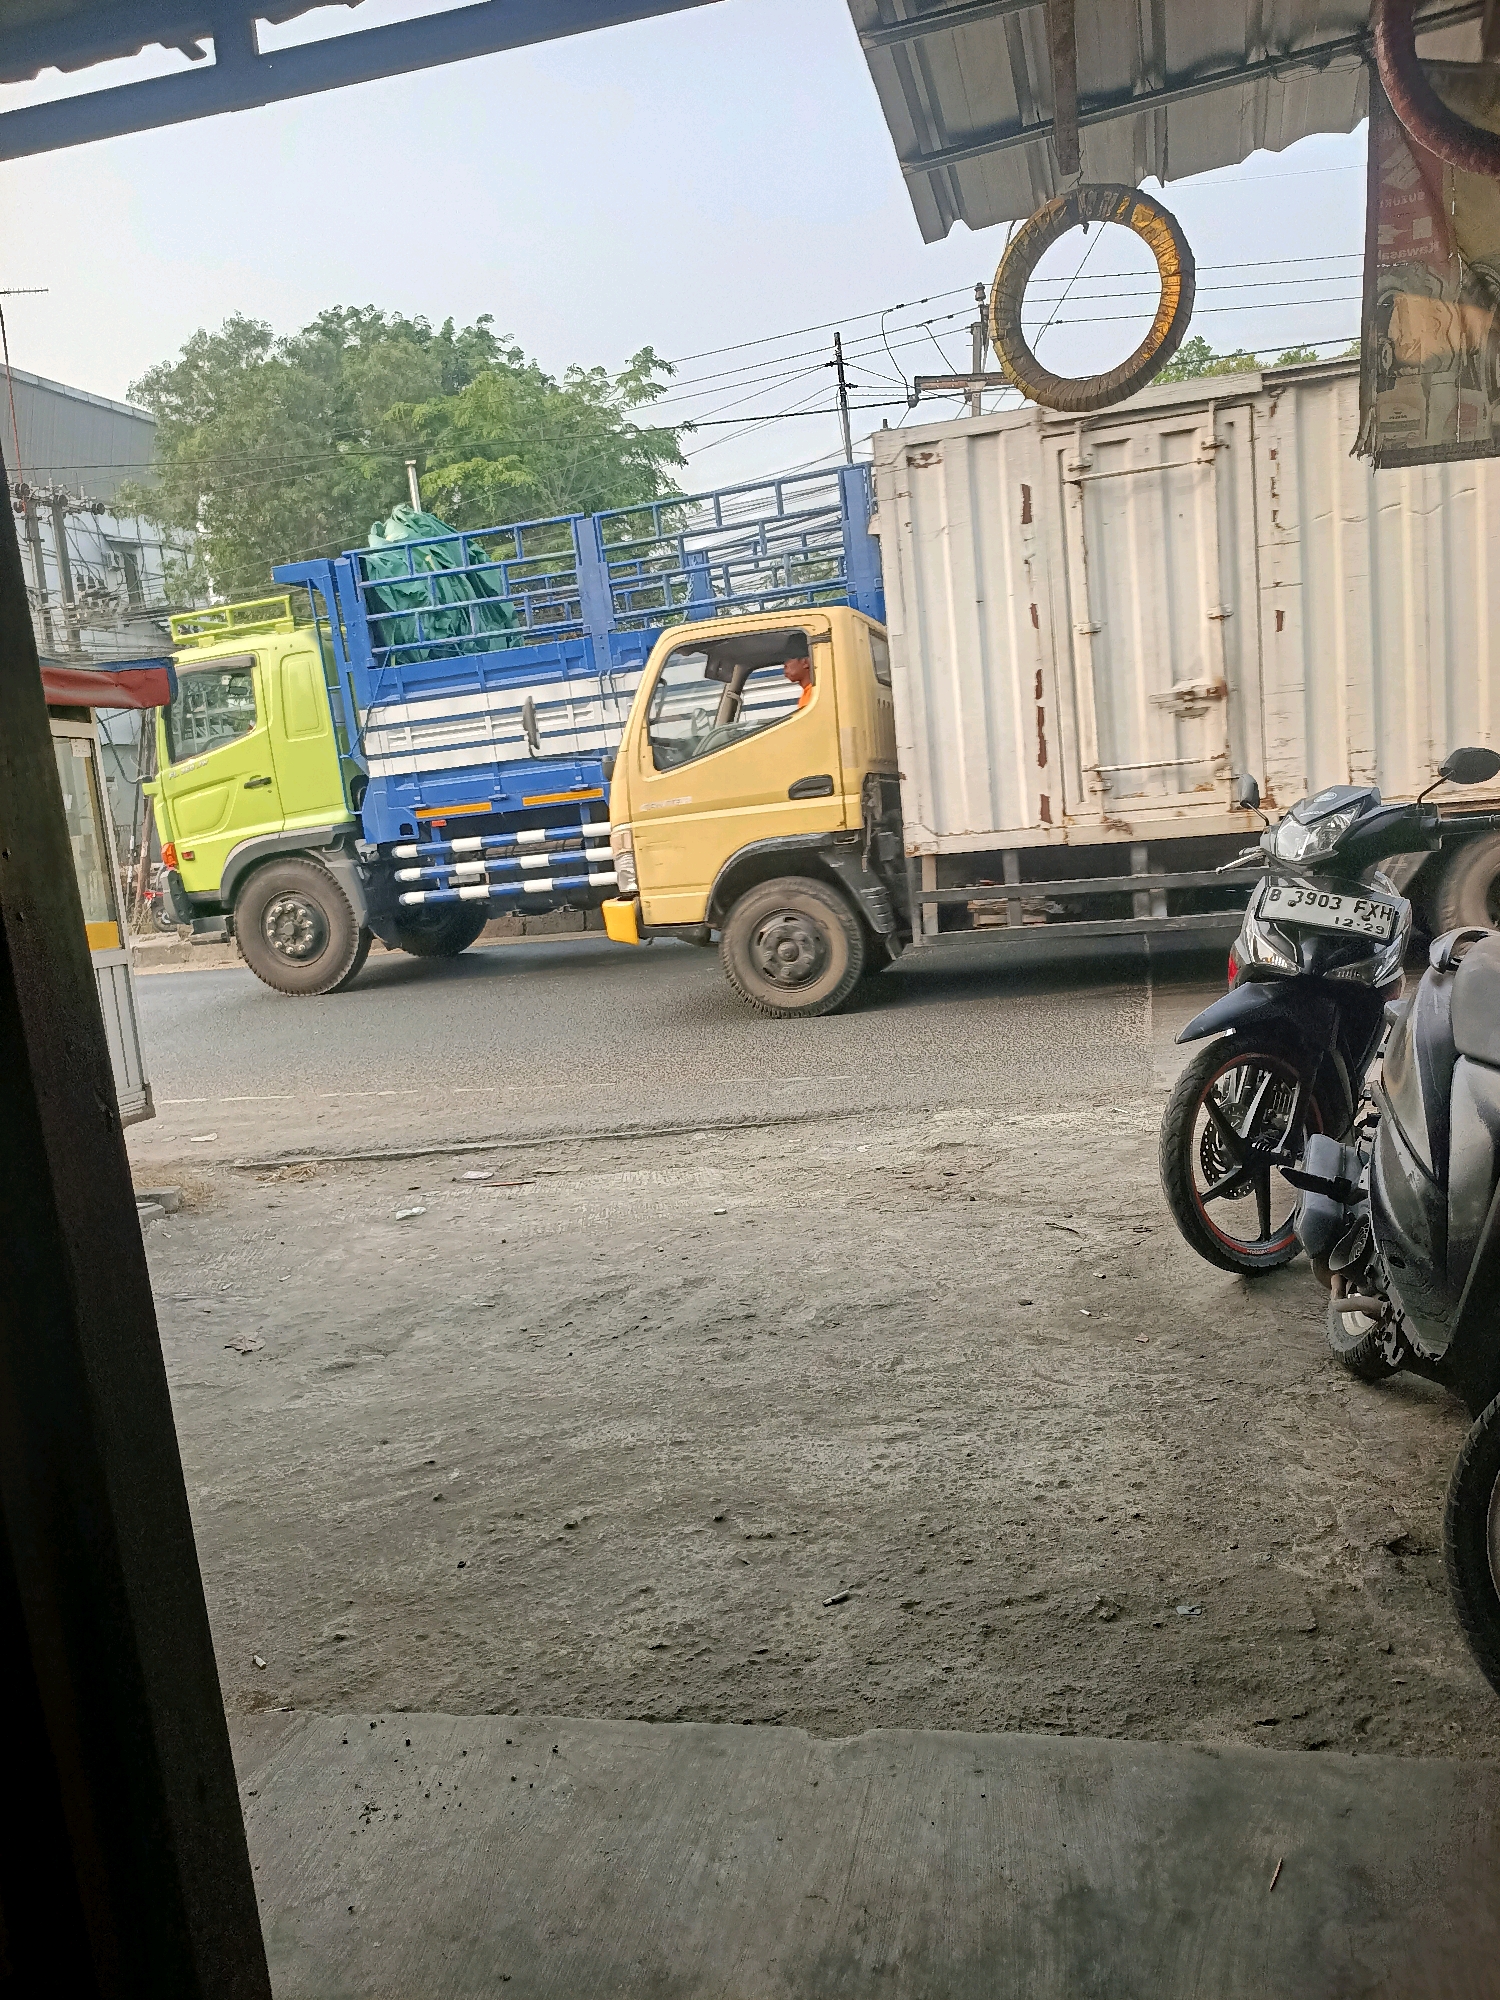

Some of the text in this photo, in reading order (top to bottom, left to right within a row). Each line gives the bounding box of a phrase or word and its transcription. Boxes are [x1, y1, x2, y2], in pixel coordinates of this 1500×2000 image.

[1269, 889, 1393, 921] B 3903 FXH
